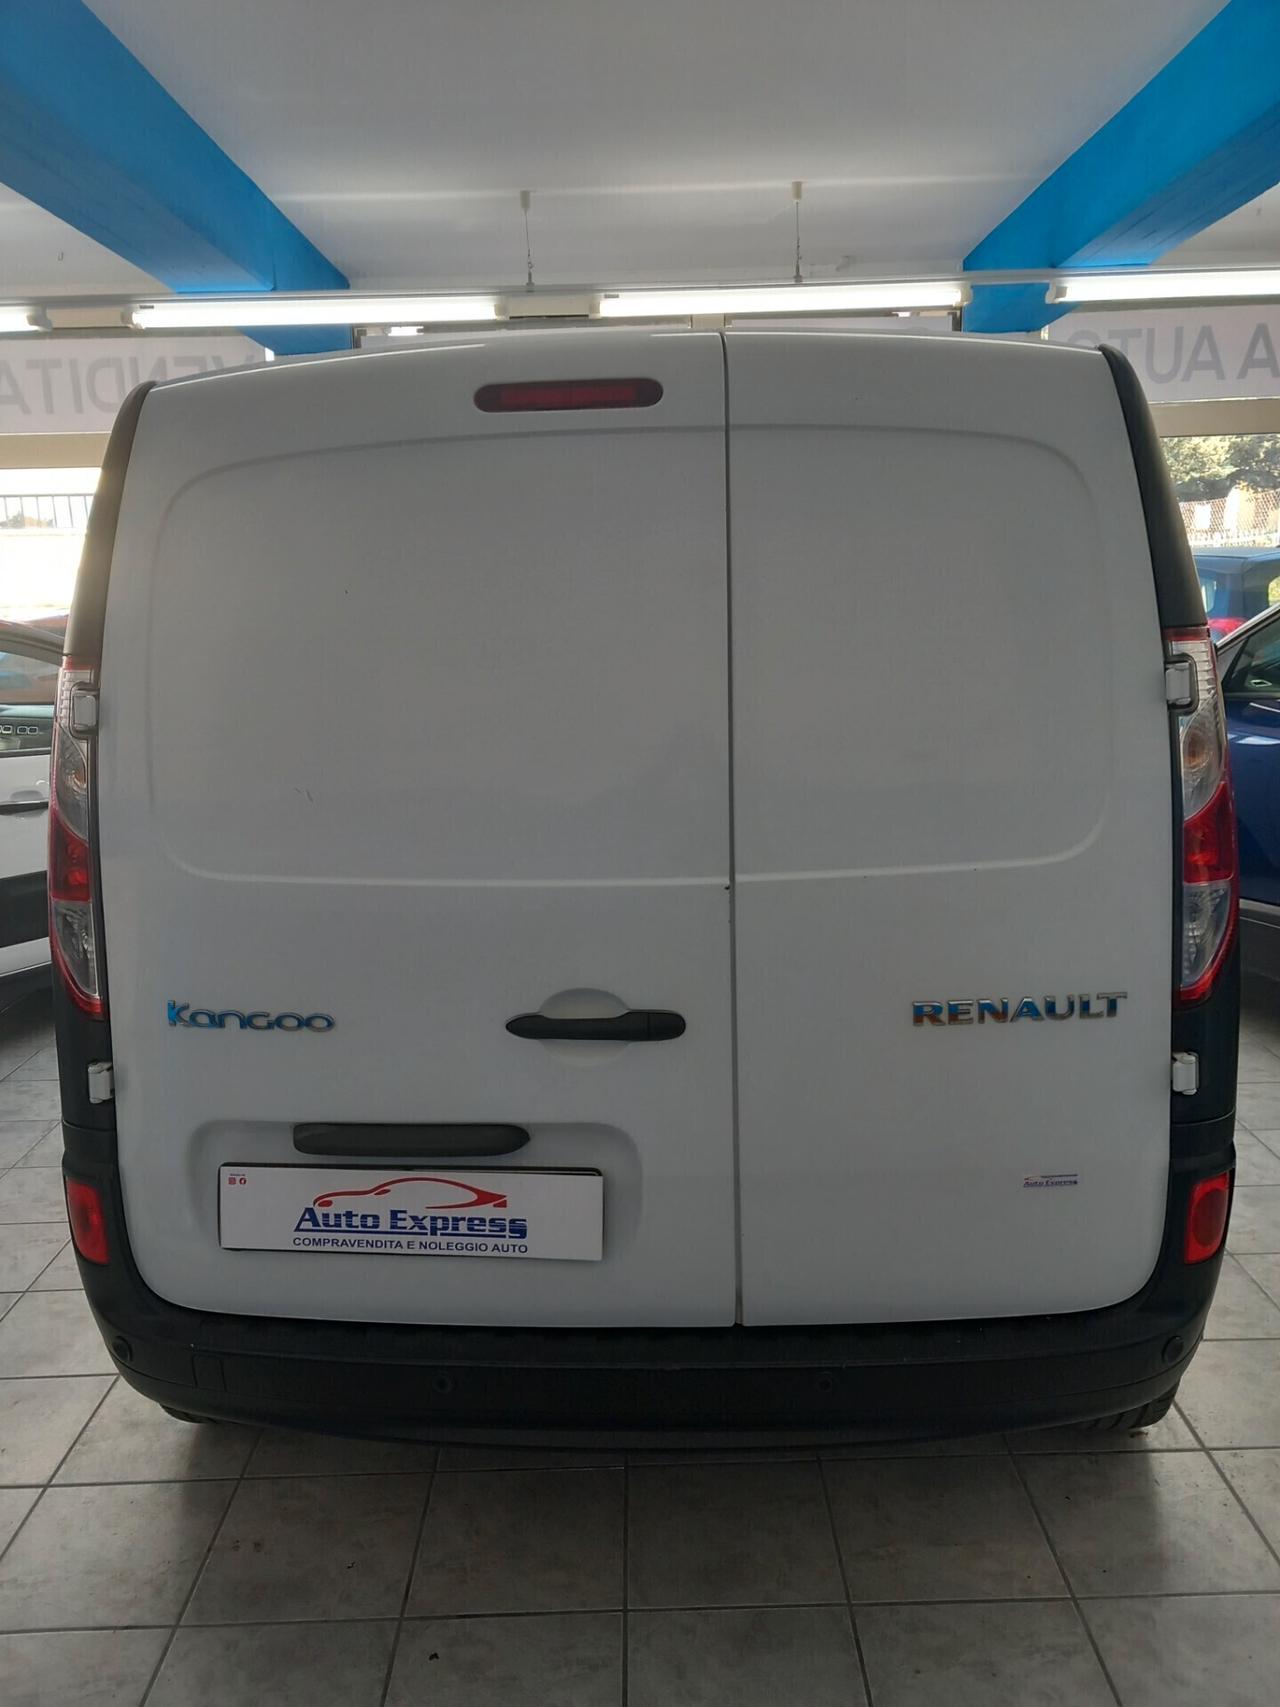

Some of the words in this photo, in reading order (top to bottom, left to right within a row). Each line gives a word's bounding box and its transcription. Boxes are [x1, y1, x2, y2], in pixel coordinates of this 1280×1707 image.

[911, 991, 1128, 1027] RENAULT
[294, 1207, 380, 1233] Auto
[389, 1209, 528, 1240] Express
[292, 1237, 404, 1250] COMPRAVENDITA
[406, 1240, 416, 1250] E
[418, 1240, 489, 1253] NOLEGGIO
[490, 1243, 529, 1254] AUTO
